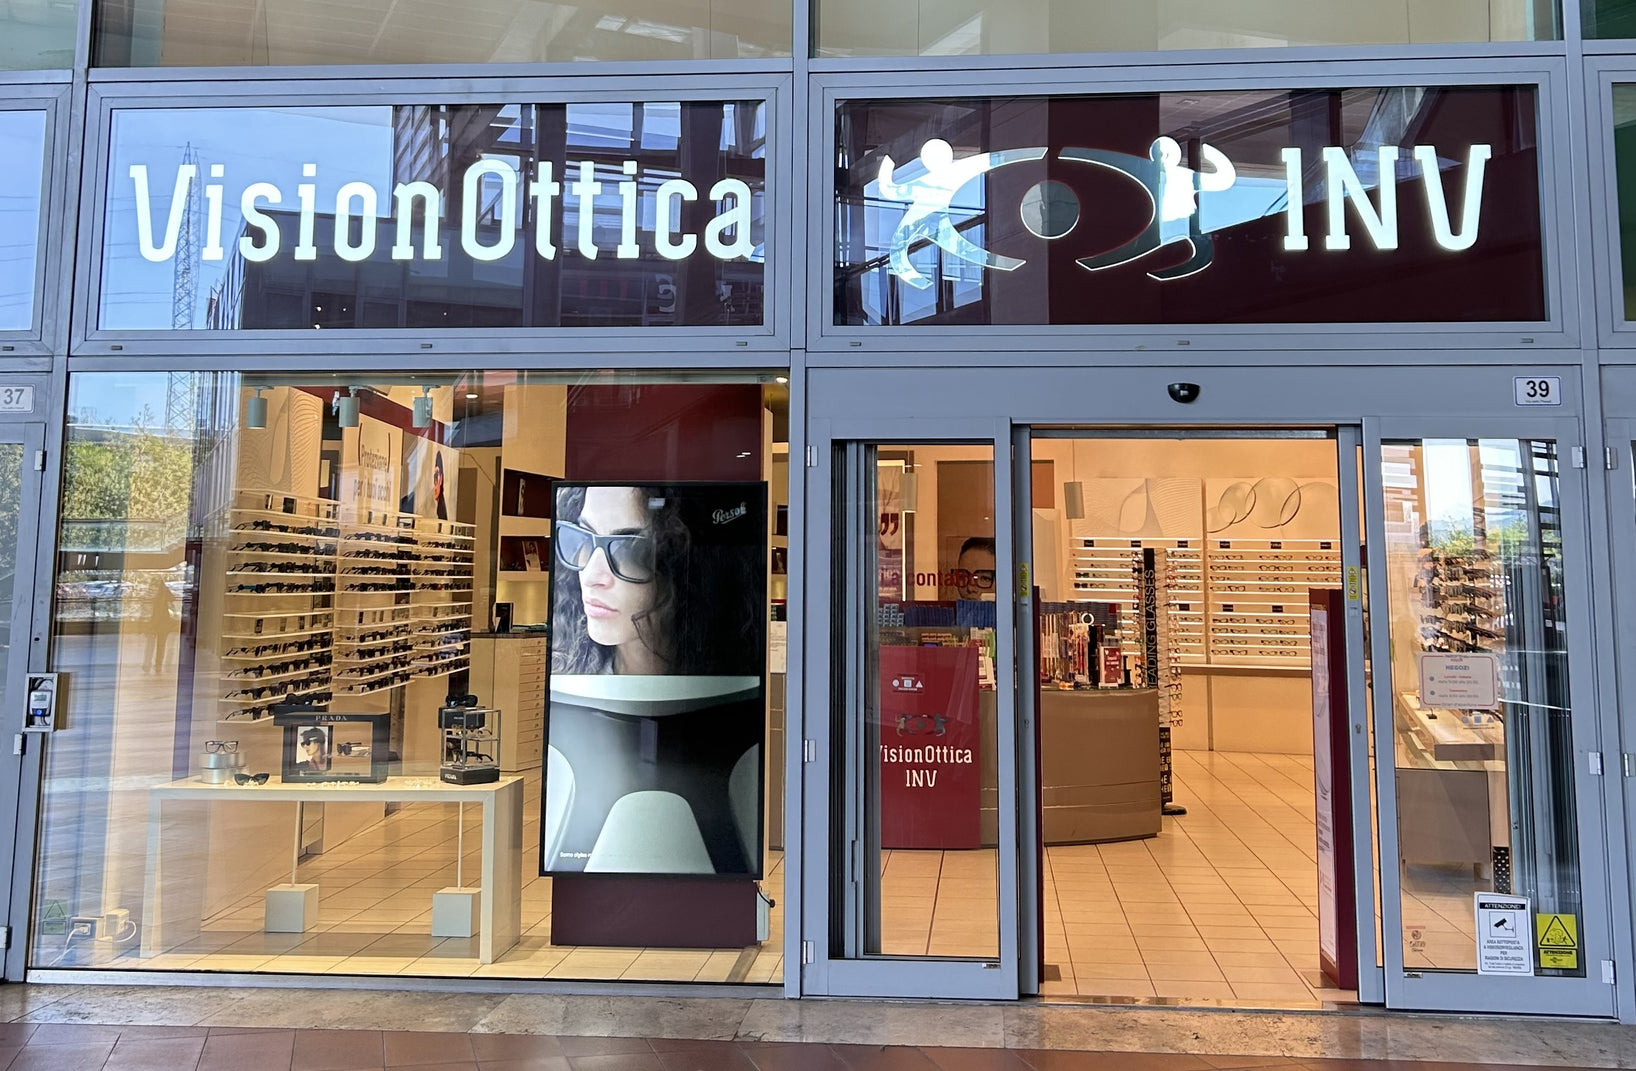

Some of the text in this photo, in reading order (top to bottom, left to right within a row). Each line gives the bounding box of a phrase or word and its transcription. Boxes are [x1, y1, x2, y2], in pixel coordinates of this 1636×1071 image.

[1281, 144, 1492, 250] INV
[129, 158, 756, 262] VisionOttica
[3, 388, 25, 405] 37
[1526, 380, 1550, 398] 39
[1145, 569, 1156, 631] GLASSES
[880, 745, 973, 763] isionOttica
[906, 770, 937, 787] INV
